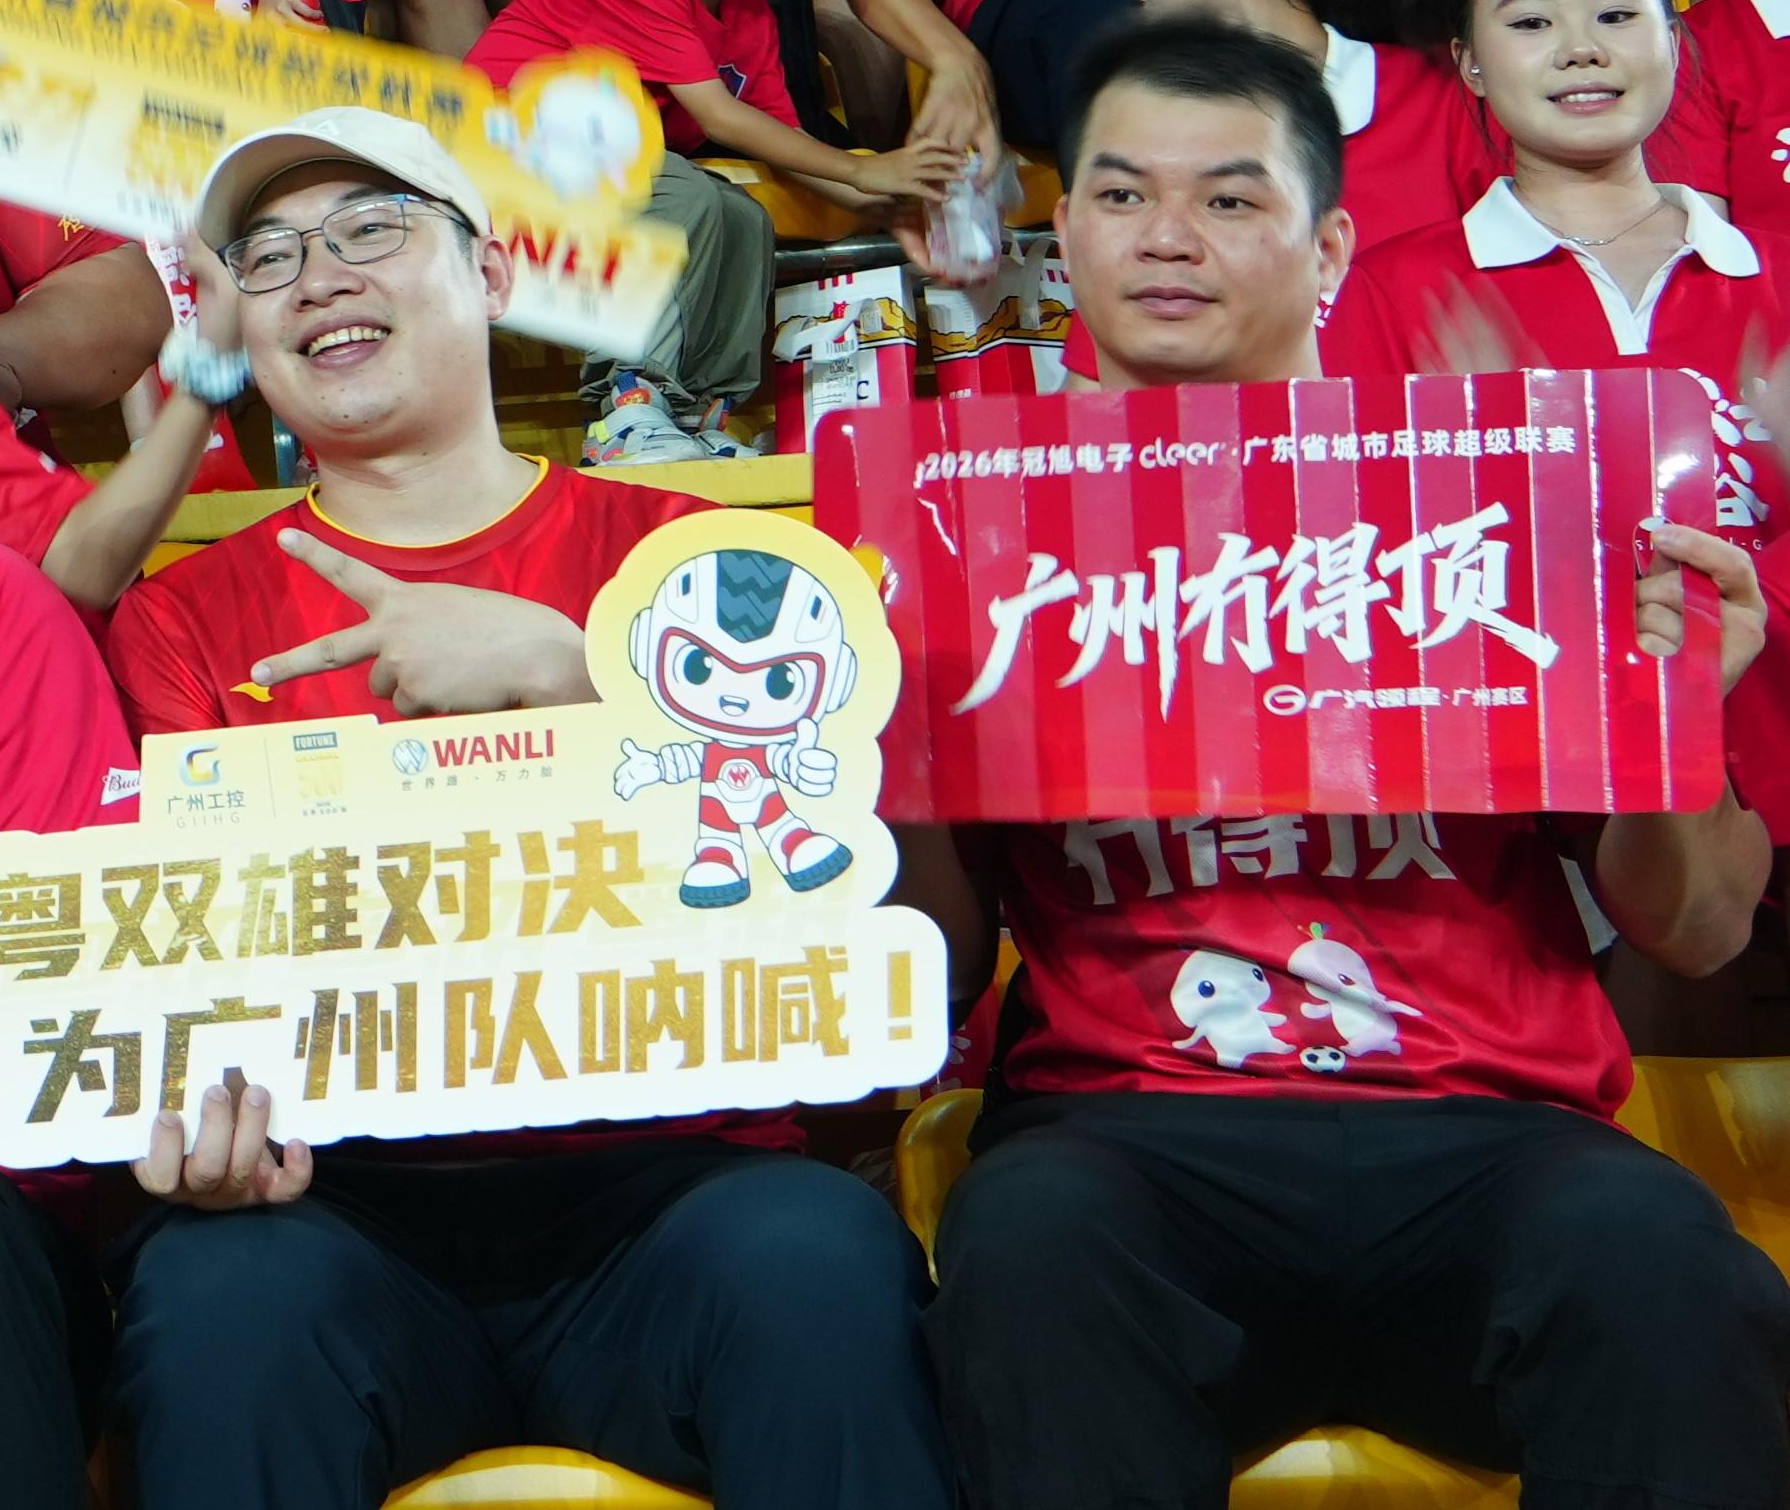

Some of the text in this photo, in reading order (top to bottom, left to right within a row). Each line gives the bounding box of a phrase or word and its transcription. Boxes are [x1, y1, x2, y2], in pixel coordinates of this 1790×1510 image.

[924, 442, 1133, 481] 2026年冠旭电子
[949, 501, 1560, 723] 广州冇得顶
[294, 734, 337, 750] FORTUNE
[433, 728, 555, 768] WANLI
[167, 789, 246, 816] 广州工控
